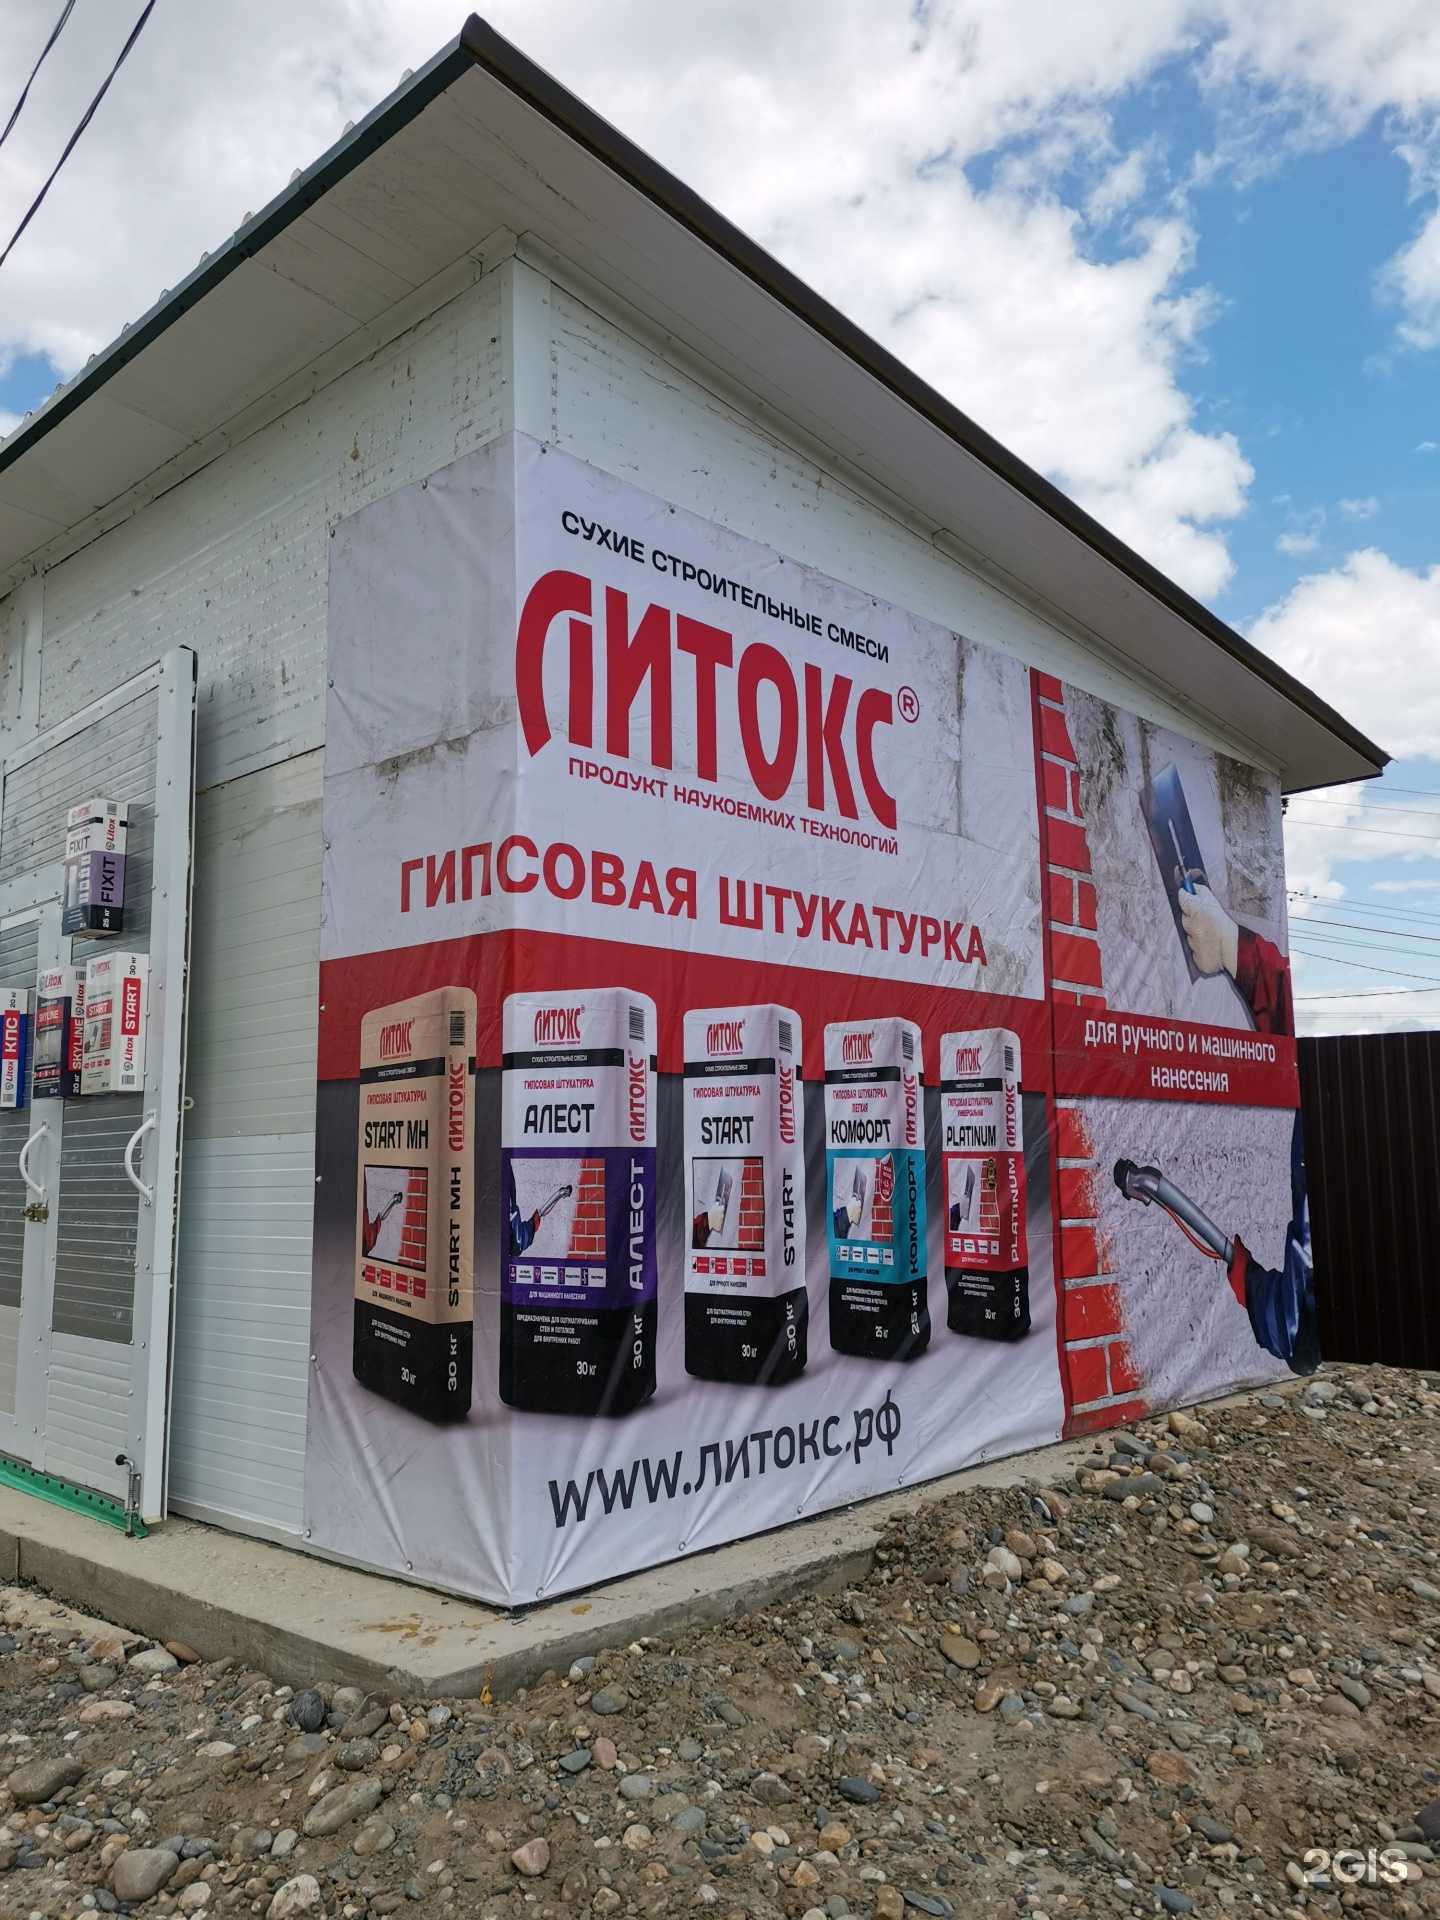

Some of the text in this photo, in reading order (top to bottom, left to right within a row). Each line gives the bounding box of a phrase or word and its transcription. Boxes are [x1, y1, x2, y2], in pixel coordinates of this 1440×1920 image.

[561, 511, 889, 663] СУХИЕ СТРОИТЕЛЬНЫЕ СМЕСИ
[568, 757, 898, 855] ПРОДУКТ НАУКОЕМКИХ ТЕХНОЛОГИЙ
[101, 856, 115, 903] FIXIT
[401, 835, 987, 966] ГИПСОВАЯ ШТУКАТУРКА
[126, 984, 137, 1029] START
[534, 1007, 581, 1045] ЛИТОКС
[5, 1017, 18, 1053] КПС
[73, 1018, 84, 1070] SKYLINE
[707, 1023, 743, 1054] ЛИТОКС
[1084, 1019, 1275, 1062] для ручного и машинного
[524, 1078, 594, 1089] ГИПСОВАЯ ШТУКАТУРКА
[629, 1057, 645, 1142] ЛИТОКС
[693, 1085, 761, 1098] ГИПСОВАЯ ШТУКАТУРКА
[1151, 1066, 1229, 1092] нанесения
[448, 1063, 465, 1151] ЛИТОКС
[524, 1104, 595, 1133] АЛЕСТ
[780, 1066, 795, 1144] ЛИТОКС
[904, 1075, 917, 1145] ЛИТОКС
[1006, 1085, 1016, 1147] ЛИТОКС
[365, 1121, 404, 1149] START
[701, 1116, 754, 1144] START
[832, 1119, 891, 1144] КОМФОРТ
[947, 1125, 996, 1147] PLATINUM
[629, 1158, 644, 1290] АЛЕСТ
[783, 1168, 795, 1266] START
[908, 1156, 918, 1274] КОМФОРТ
[1008, 1158, 1019, 1263] PLATINUM
[449, 1219, 460, 1307] START
[786, 1301, 796, 1351] 30 кг
[911, 1313, 920, 1335] 25
[1013, 1296, 1020, 1318] 30
[448, 1333, 457, 1391] 30 кг
[633, 1315, 643, 1369] 30 кг
[742, 1344, 751, 1357] 30
[401, 1367, 409, 1382] 30
[576, 1361, 588, 1376] 30
